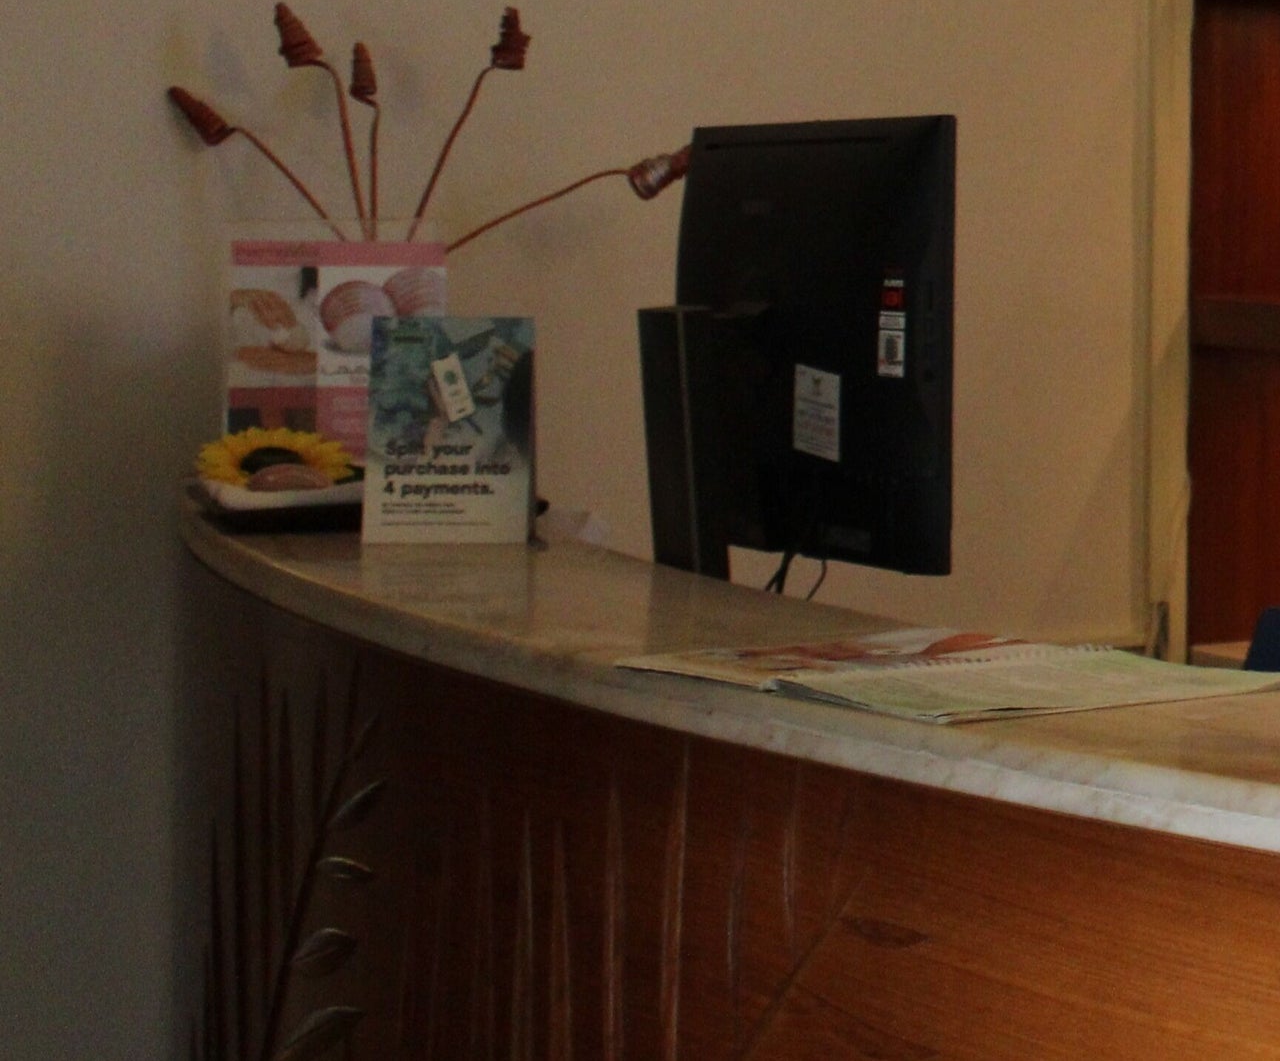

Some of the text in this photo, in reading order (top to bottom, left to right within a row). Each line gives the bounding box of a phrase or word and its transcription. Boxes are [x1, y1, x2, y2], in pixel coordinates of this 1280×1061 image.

[433, 444, 473, 459] your
[384, 460, 512, 479] purchase into
[383, 481, 495, 499] 4 payments.
